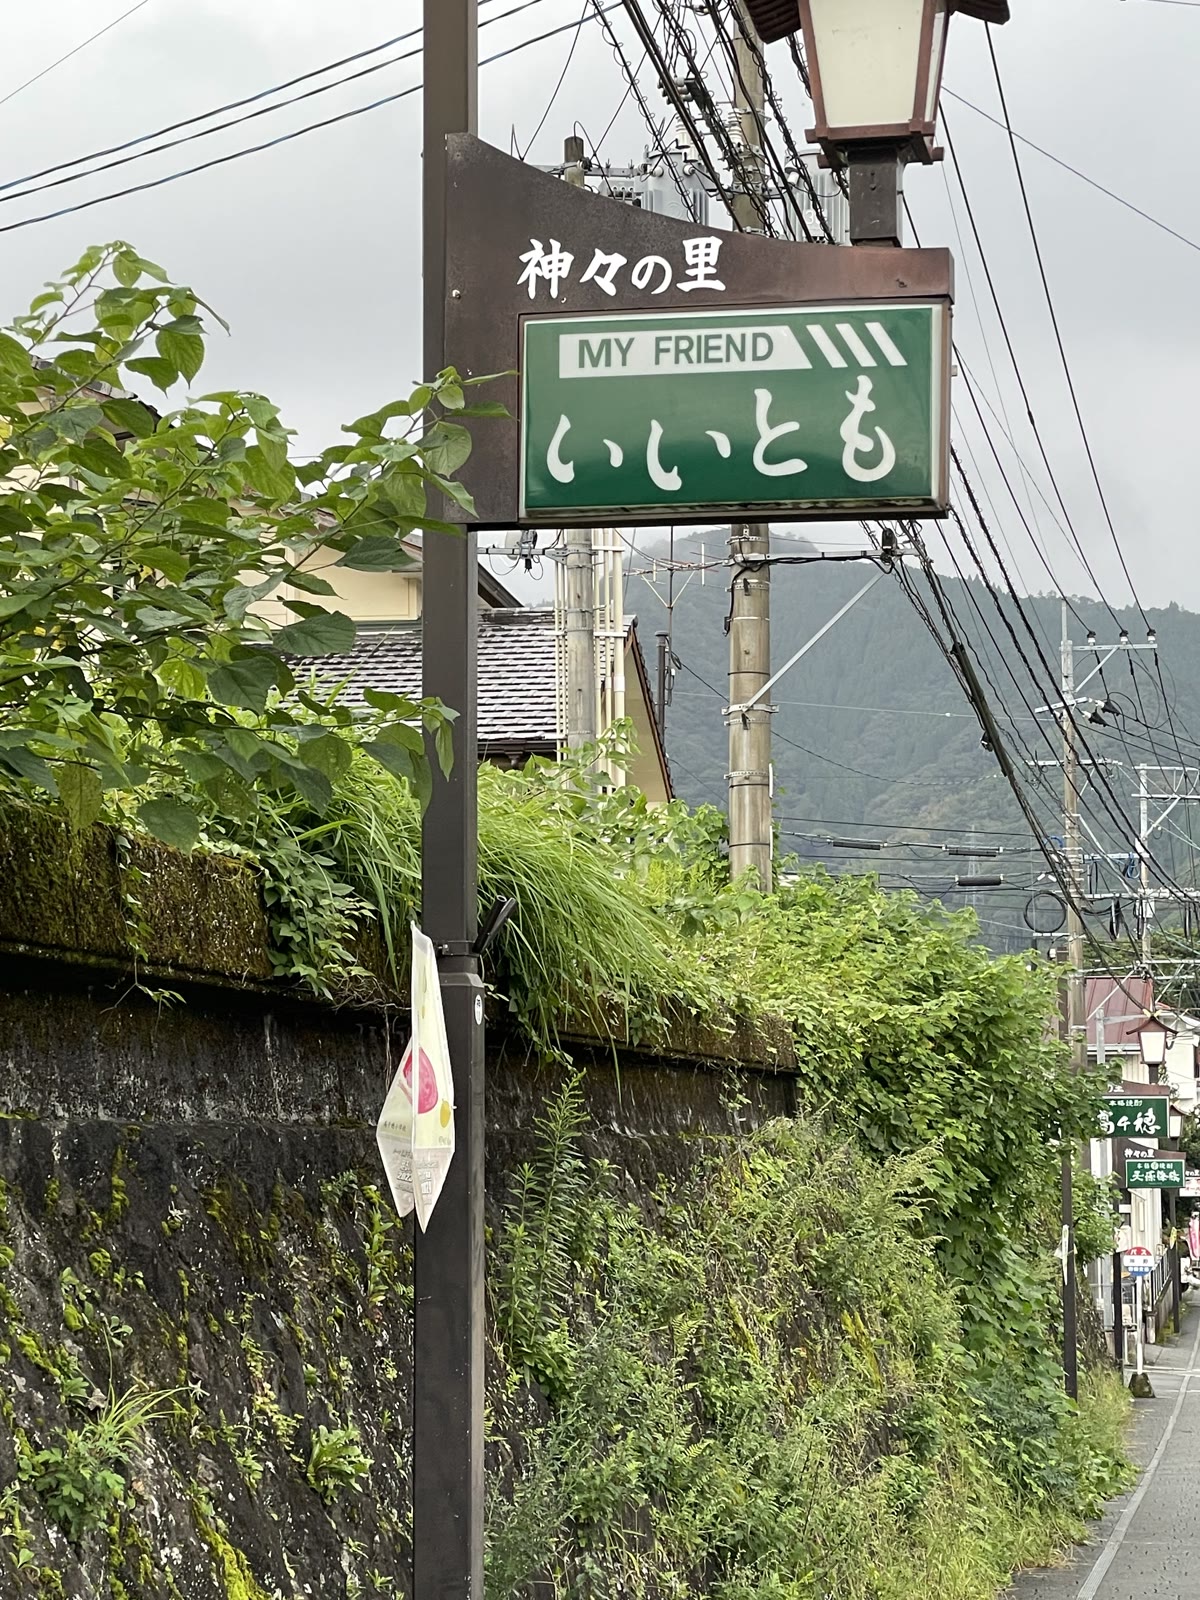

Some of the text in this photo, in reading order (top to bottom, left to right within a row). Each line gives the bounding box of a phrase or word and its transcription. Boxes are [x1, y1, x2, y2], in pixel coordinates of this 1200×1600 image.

[517, 236, 726, 300] 神々の里
[578, 332, 774, 369] MY FRIEND
[547, 374, 896, 491] いいとも
[1109, 1099, 1143, 1107] 本格焼酎
[1097, 1107, 1162, 1135] 高千穂
[1124, 1148, 1155, 1158] 神々の里
